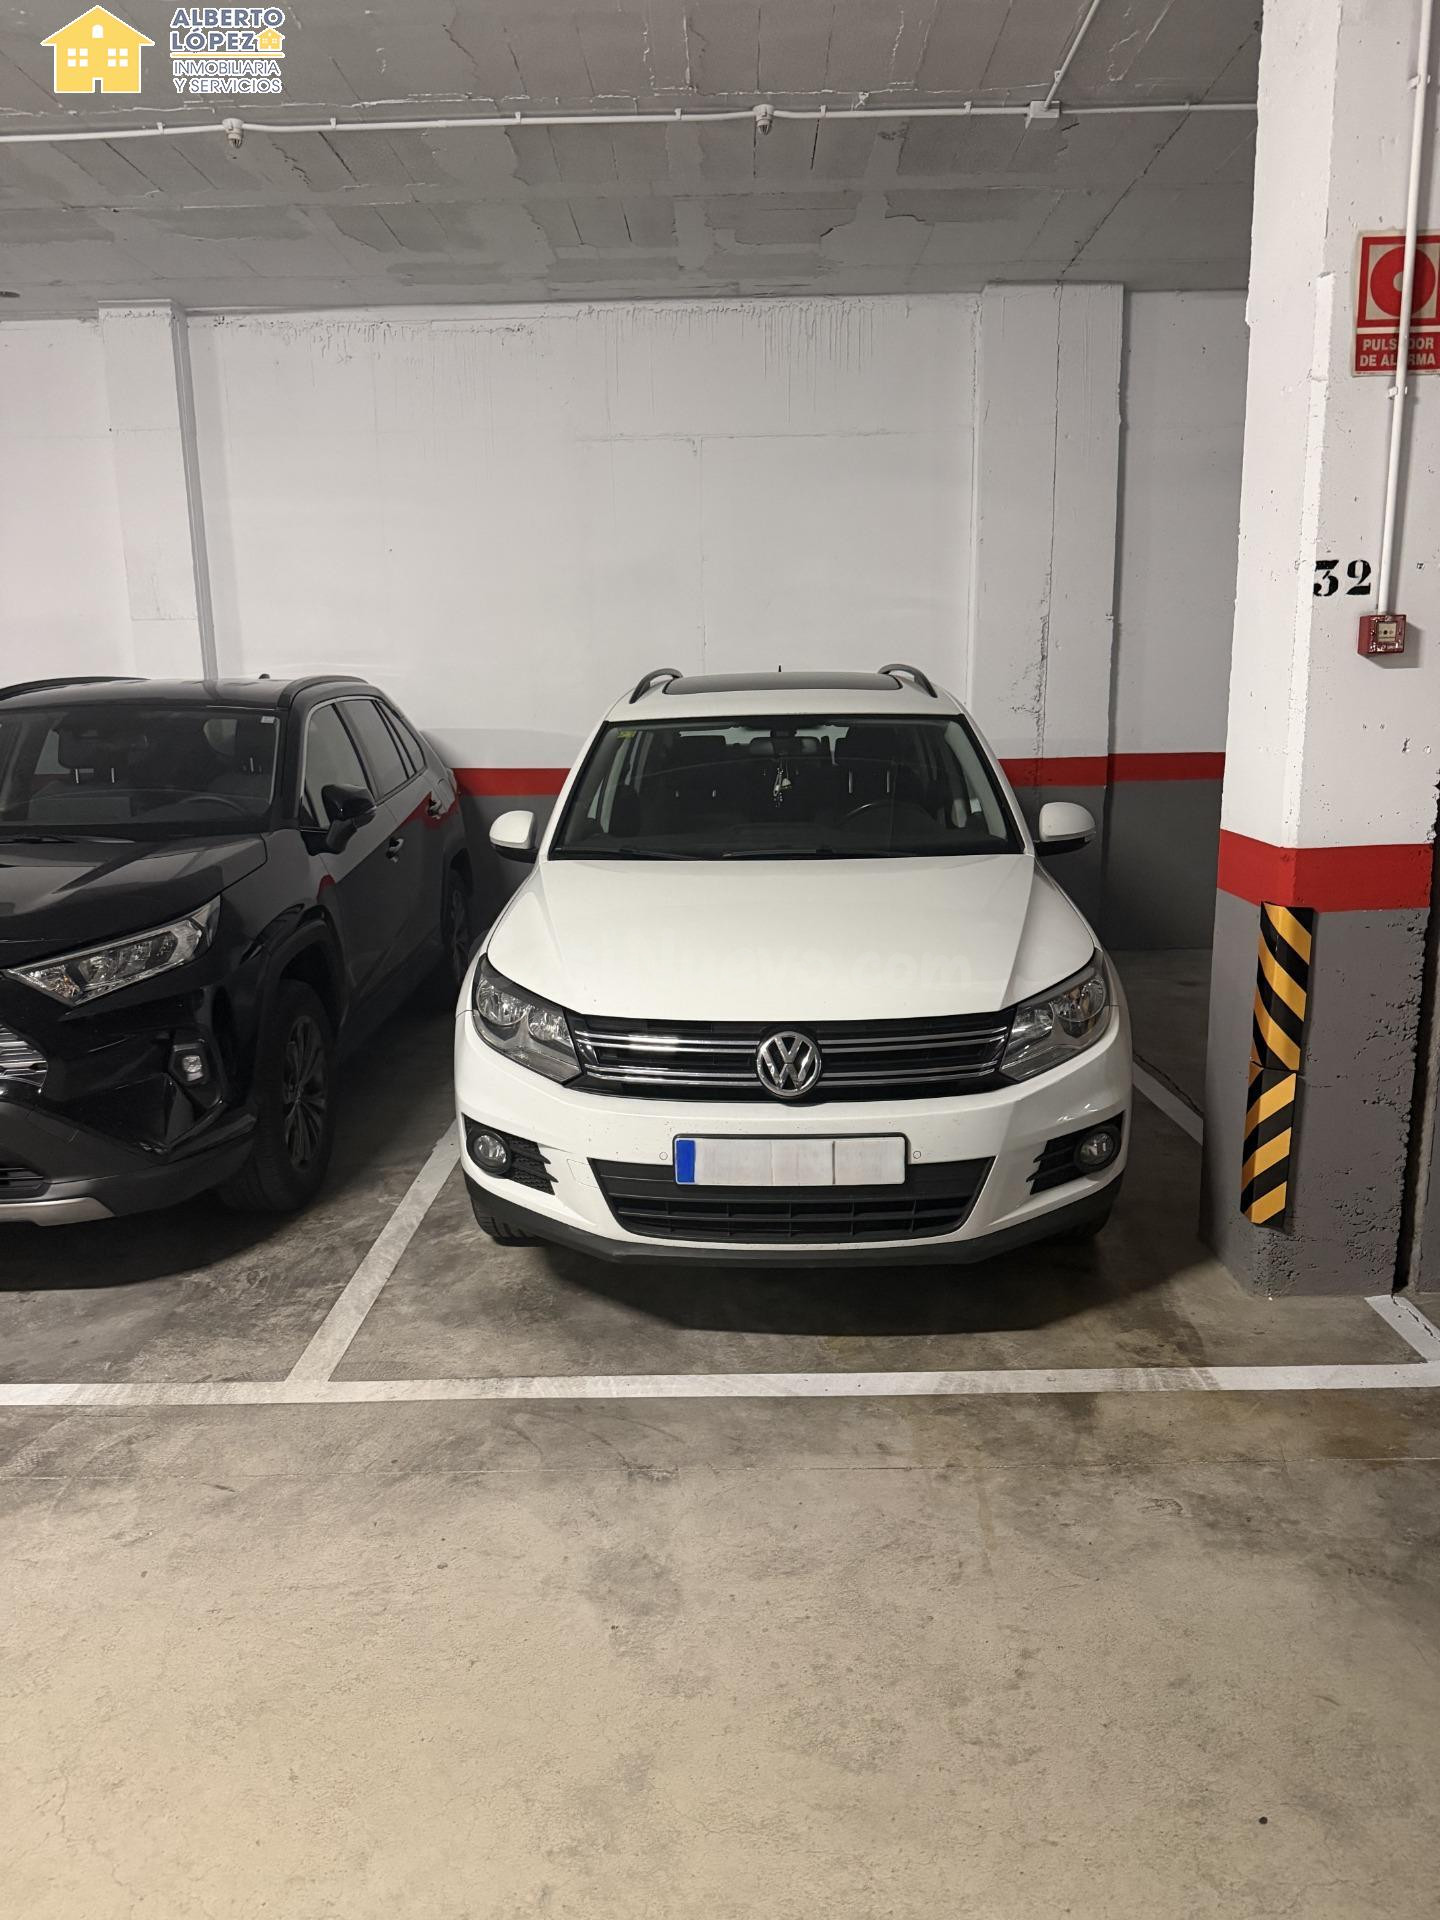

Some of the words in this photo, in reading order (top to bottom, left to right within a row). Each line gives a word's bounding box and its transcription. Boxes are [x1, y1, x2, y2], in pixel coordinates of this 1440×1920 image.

[1362, 337, 1435, 351] PULSDOR
[1359, 354, 1377, 367] DE
[1380, 352, 1436, 367] ALRMA
[1313, 560, 1371, 597] 32
[757, 1031, 822, 1098] VW
